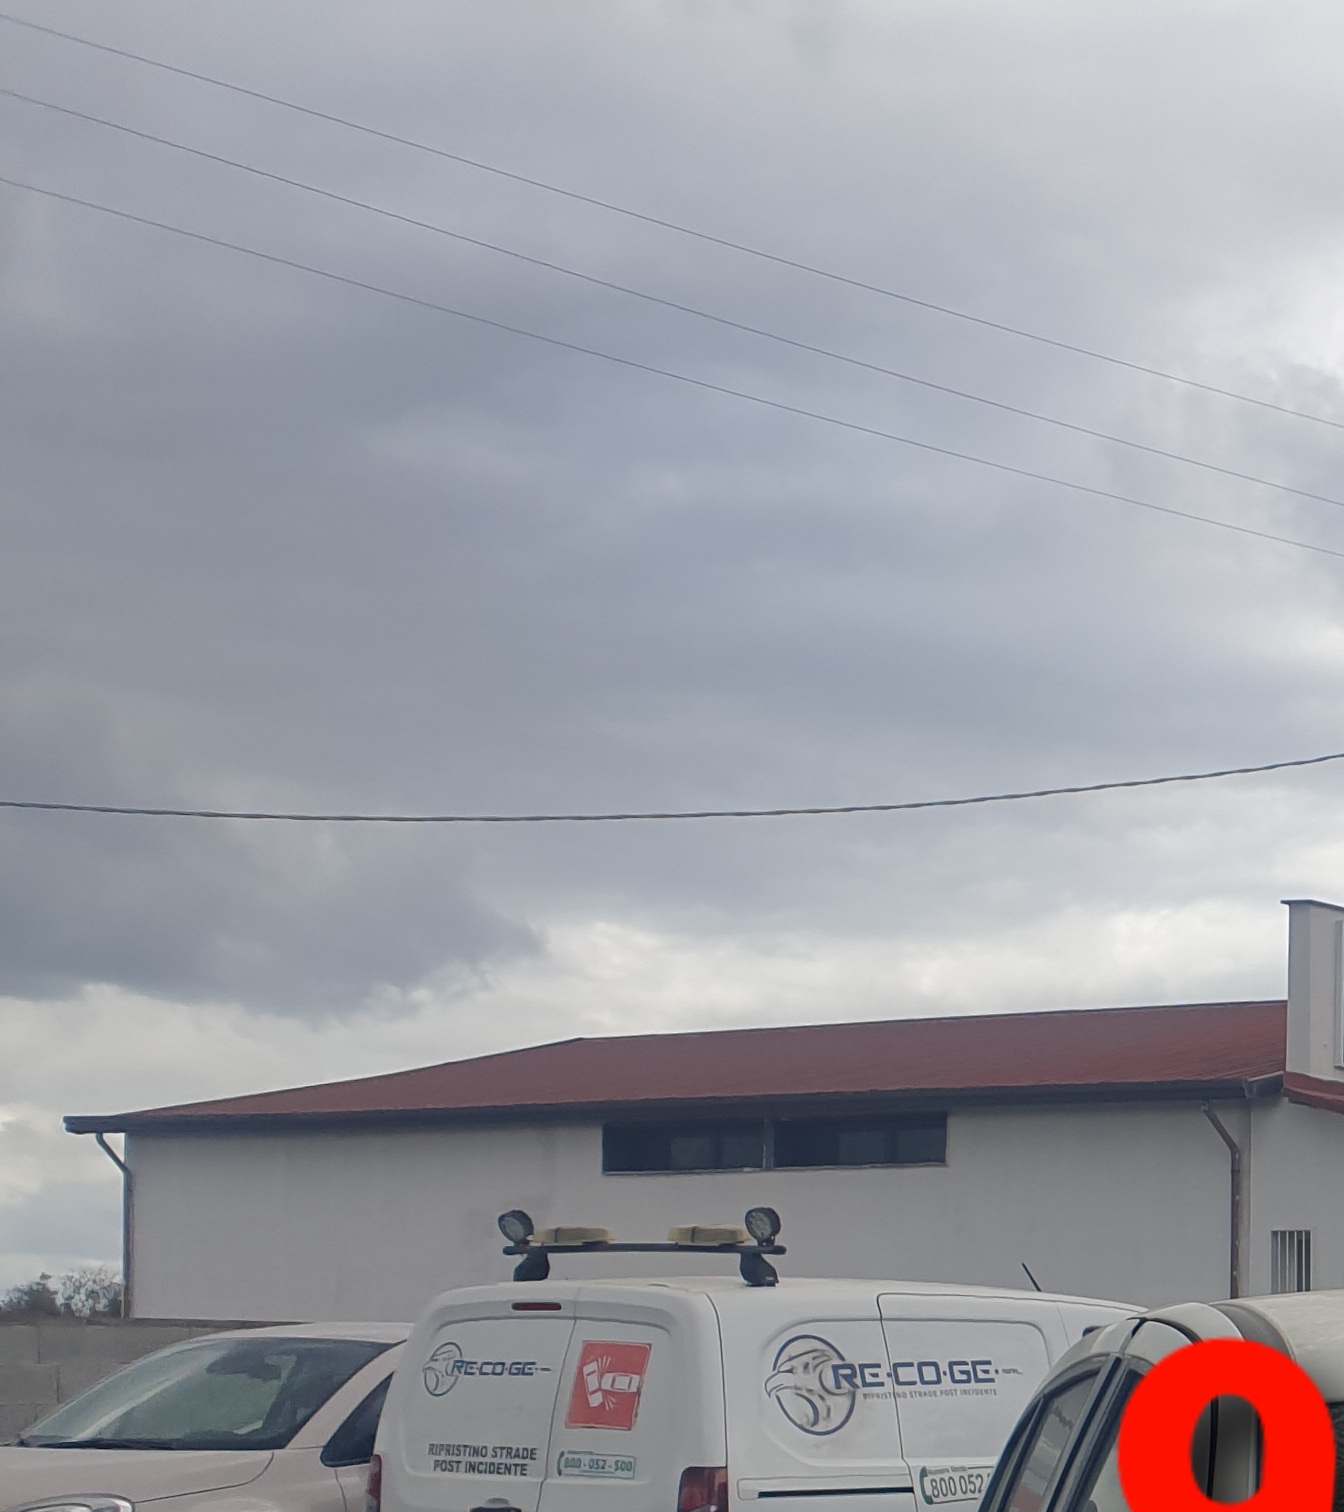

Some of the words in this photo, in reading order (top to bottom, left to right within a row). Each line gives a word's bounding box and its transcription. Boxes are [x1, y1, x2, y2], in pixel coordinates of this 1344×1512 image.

[939, 1389, 958, 1398] POST
[428, 1443, 489, 1458] RIPRISTINO
[490, 1446, 538, 1461] STRADE
[433, 1459, 461, 1473] POST
[464, 1461, 528, 1476] INCIDENTE
[930, 1475, 957, 1498] 800
